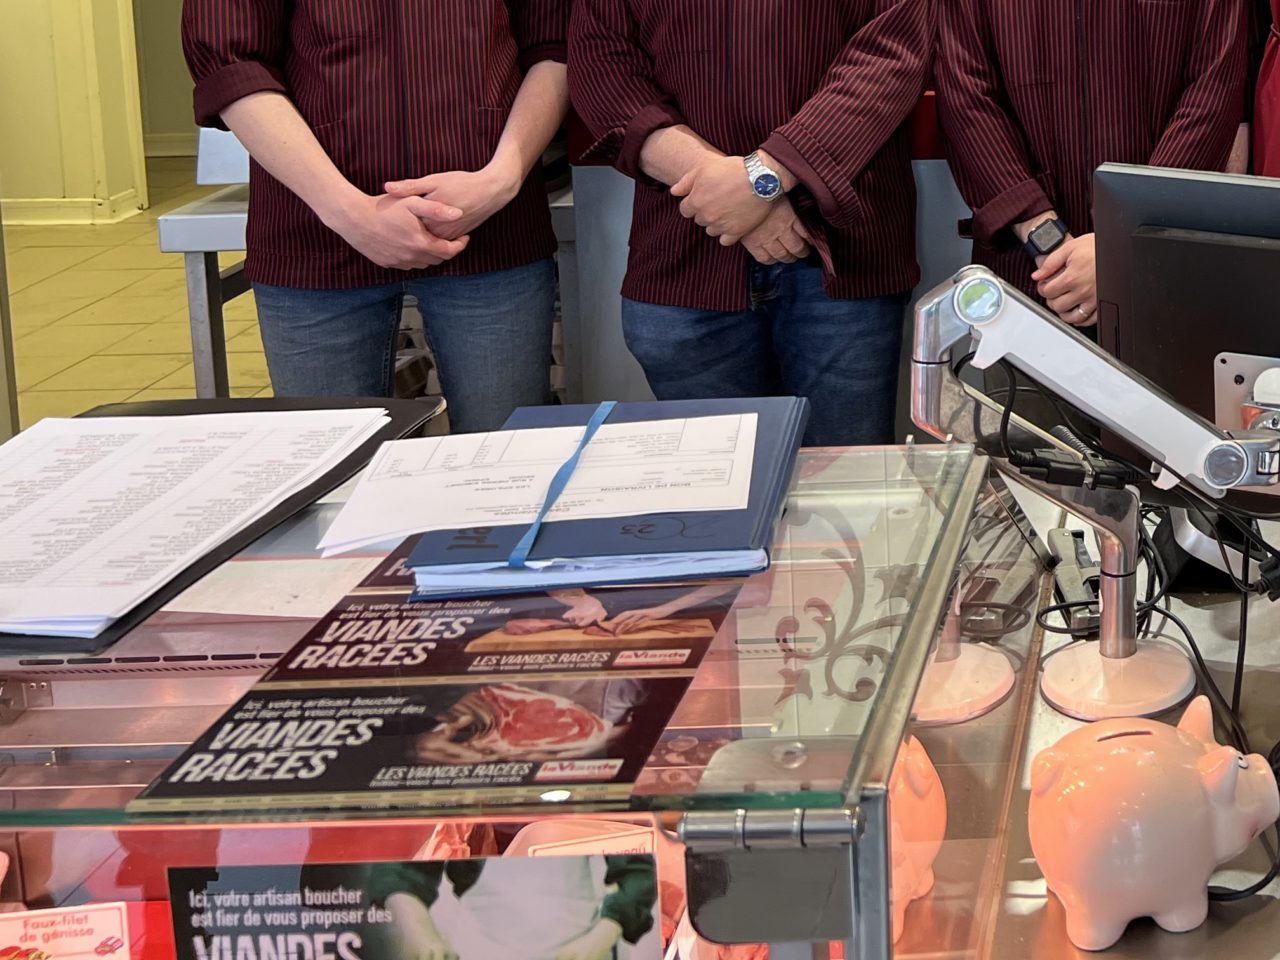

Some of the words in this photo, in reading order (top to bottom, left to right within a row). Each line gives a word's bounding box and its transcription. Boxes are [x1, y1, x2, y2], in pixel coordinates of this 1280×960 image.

[431, 608, 487, 618] proposer
[445, 600, 495, 608] boucher
[320, 617, 475, 643] VIANDES
[288, 639, 437, 669] RACÉES
[473, 654, 499, 666] LES
[501, 653, 555, 665] VIANDES
[559, 651, 611, 663] RACÉES
[269, 700, 301, 709] votre
[303, 698, 349, 708] artisan
[352, 696, 407, 706] boucher
[234, 710, 256, 720] est
[257, 709, 282, 719] fier
[284, 709, 302, 718] de
[304, 708, 335, 717] vous
[337, 706, 401, 718] proposer
[401, 705, 426, 715] des
[208, 717, 383, 750] VIANDES
[168, 746, 338, 783] RACÉES
[376, 767, 407, 780] LES
[407, 765, 472, 779] VIANDES
[474, 762, 534, 777] RACÉES
[189, 889, 210, 908] Ici,
[214, 890, 250, 907] votre
[253, 888, 301, 907] artisan
[304, 886, 362, 905] boucher
[23, 915, 88, 930] Faux-filet
[191, 910, 213, 927] est
[216, 909, 239, 927] fier
[243, 909, 261, 926] de
[263, 911, 298, 926] vous
[301, 909, 363, 929] proposer
[367, 906, 393, 924] des
[19, 933, 37, 943] de
[42, 927, 95, 943] génisse
[192, 932, 363, 960] VIANDES
